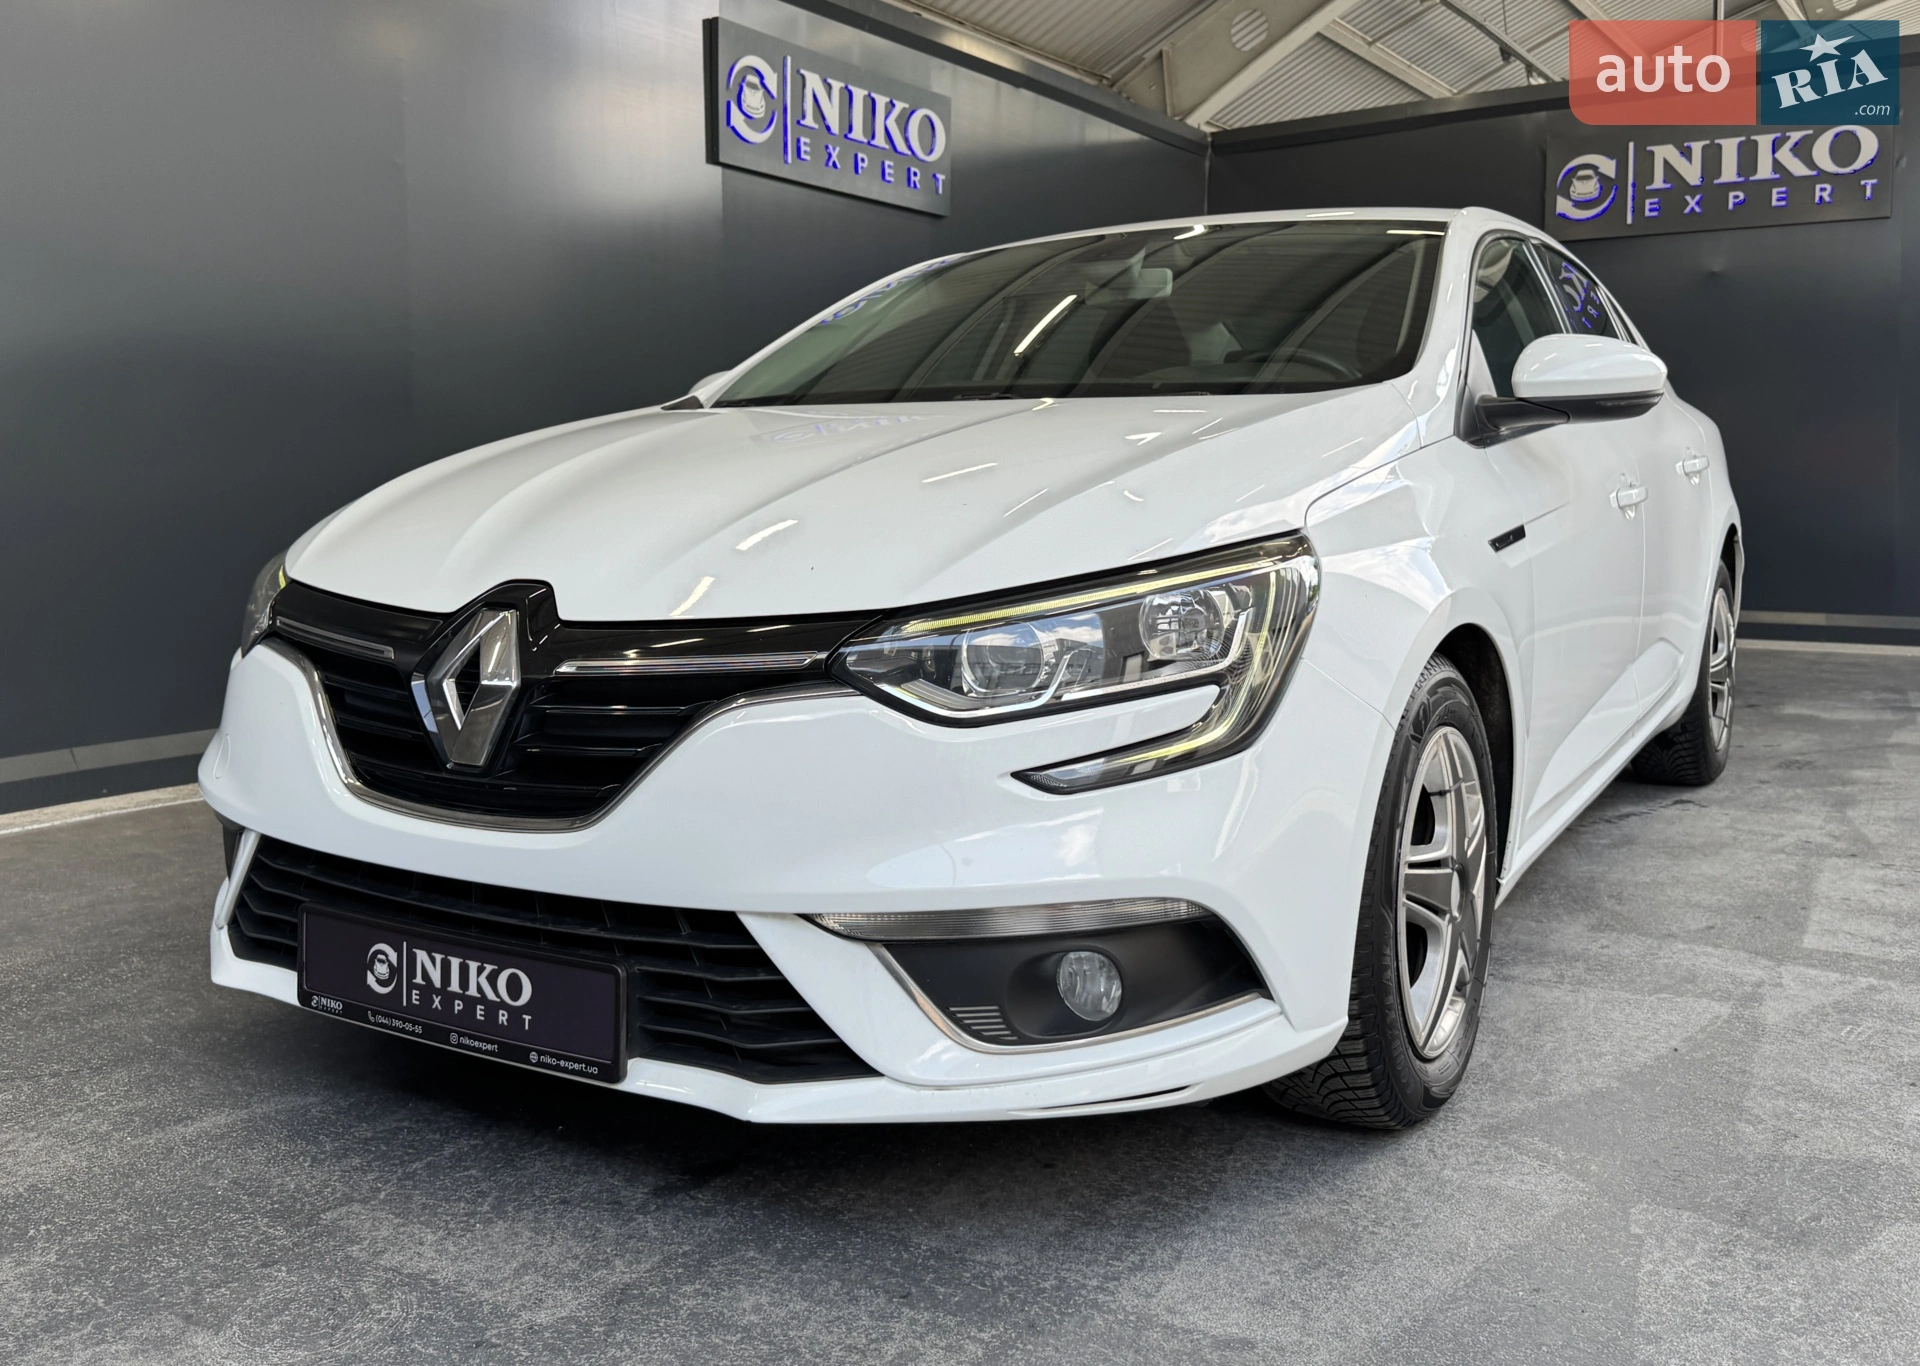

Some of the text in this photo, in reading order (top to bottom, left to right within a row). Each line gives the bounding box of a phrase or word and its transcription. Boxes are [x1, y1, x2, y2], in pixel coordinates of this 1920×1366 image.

[796, 68, 947, 163] NIKO
[796, 136, 946, 195] EXPERT
[1645, 125, 1880, 191] NIKO
[1644, 178, 1879, 218] EXPERT
[411, 948, 533, 1007] NIKO
[320, 997, 343, 1011] NIKO
[411, 990, 532, 1031] EXPERT
[459, 1036, 499, 1053] nikoexpert
[539, 1054, 599, 1075] niko-expert.ua
